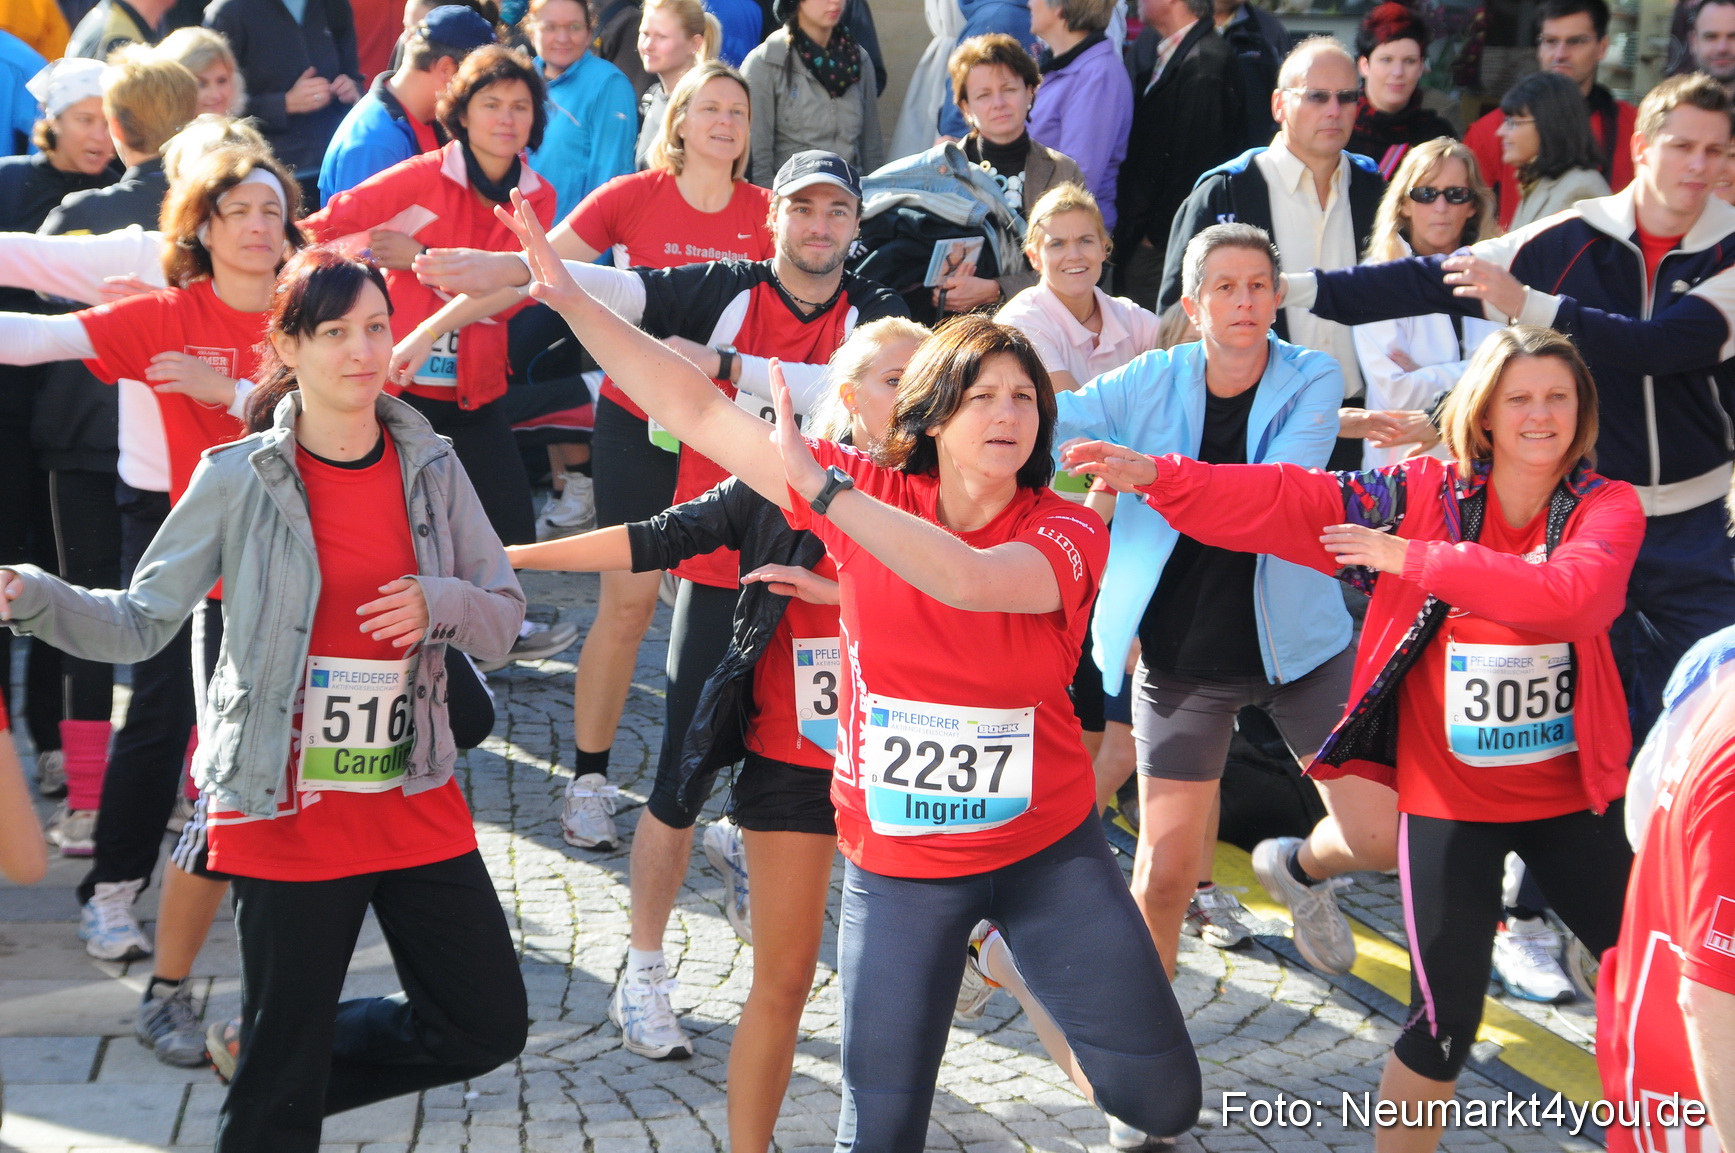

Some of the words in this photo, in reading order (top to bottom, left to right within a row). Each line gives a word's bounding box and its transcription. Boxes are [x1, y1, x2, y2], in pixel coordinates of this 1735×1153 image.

[664, 243, 682, 255] 30.
[685, 244, 748, 260] Straßenlauf
[1470, 655, 1534, 668] PFLEIDERER
[331, 671, 399, 684] PFLEIDERER
[1470, 667, 1535, 675] AKTIENGESELLSCHAFT
[331, 684, 399, 692] AKTIENGESELLSCHAFT
[812, 671, 838, 715] 3
[1464, 670, 1577, 722] 3058
[891, 711, 960, 730] PFLEIDERER
[890, 724, 960, 738] AKTIENGESELLSCHAFT
[977, 723, 1019, 734] BOCK
[309, 735, 315, 745] S
[1478, 723, 1565, 750] Monika
[883, 736, 1013, 793] 2237
[871, 774, 878, 784] D
[905, 794, 986, 825] Ingrid
